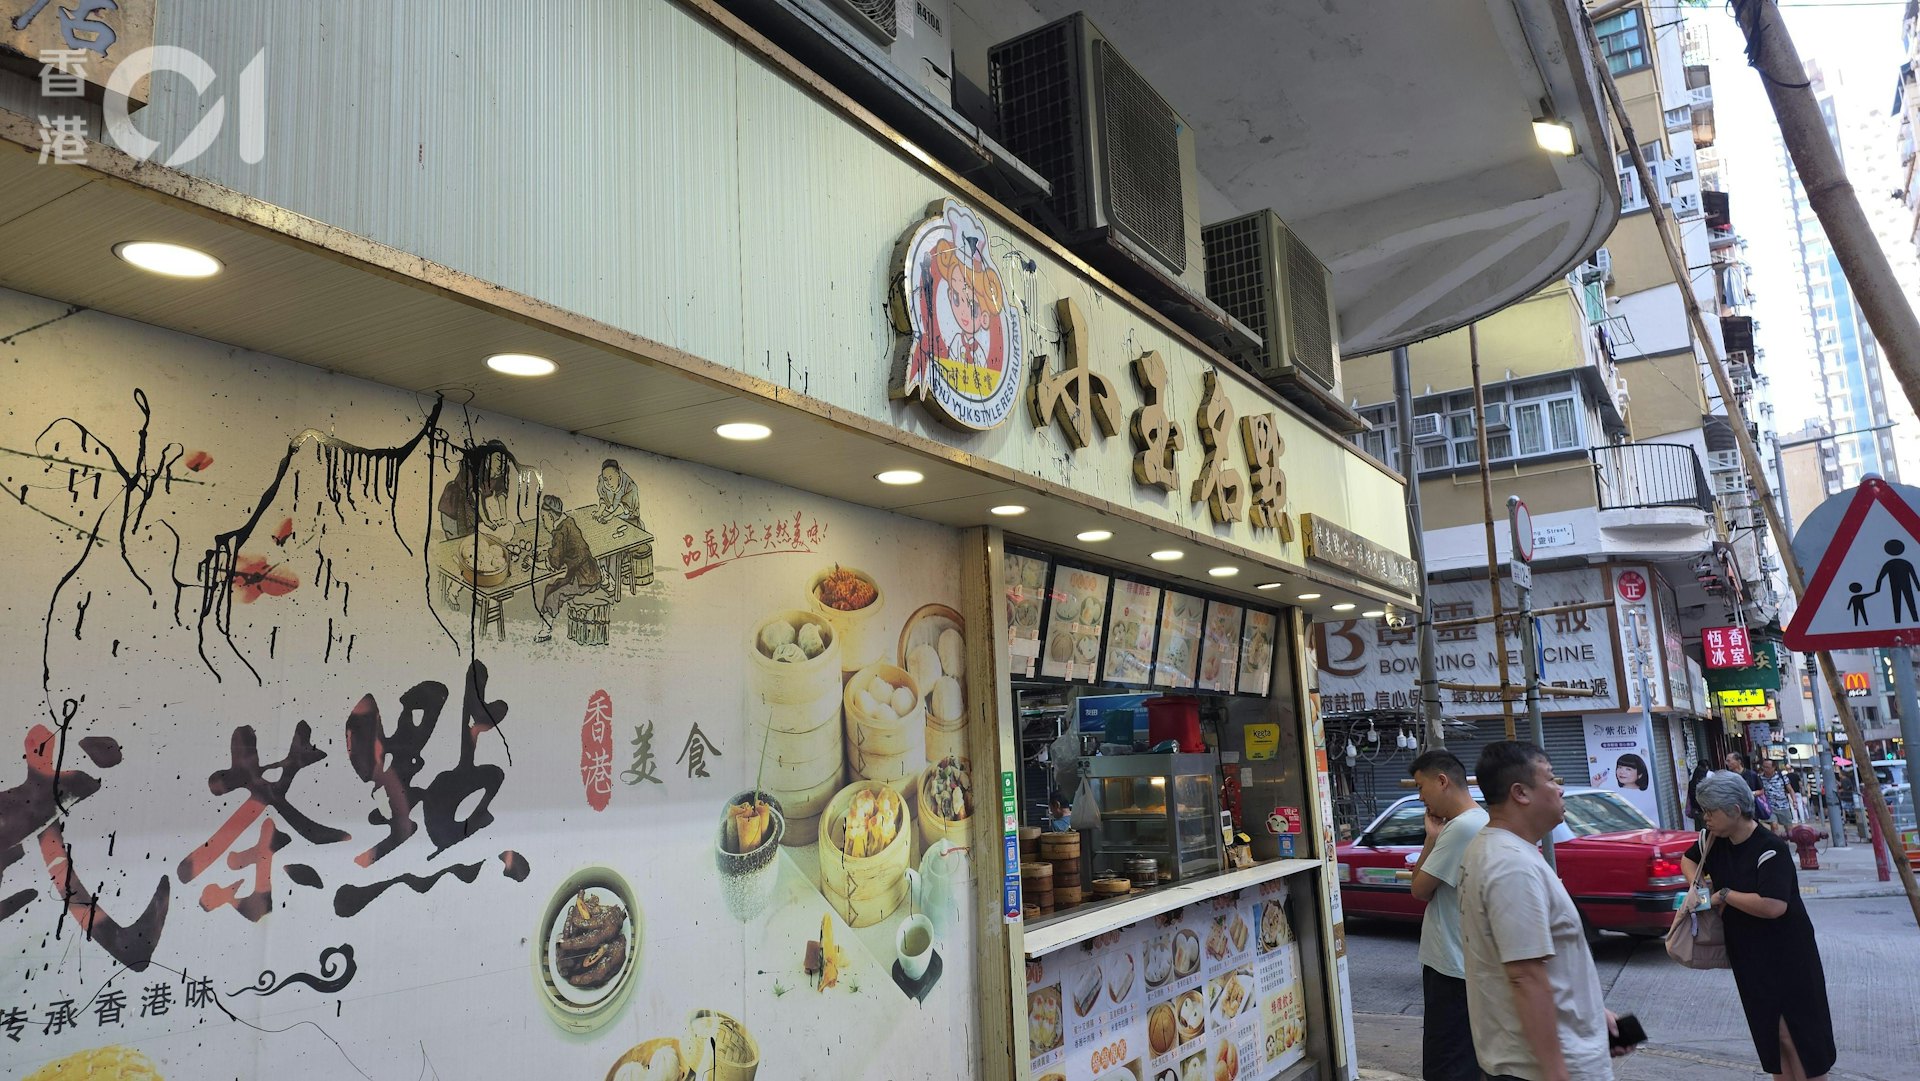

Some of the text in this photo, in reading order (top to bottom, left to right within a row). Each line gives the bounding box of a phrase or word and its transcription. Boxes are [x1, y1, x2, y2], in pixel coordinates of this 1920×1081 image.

[1626, 583, 1641, 598] 正
[1707, 628, 1742, 648] 恆香
[1711, 648, 1746, 666] 冰室
[620, 719, 723, 785] 美食
